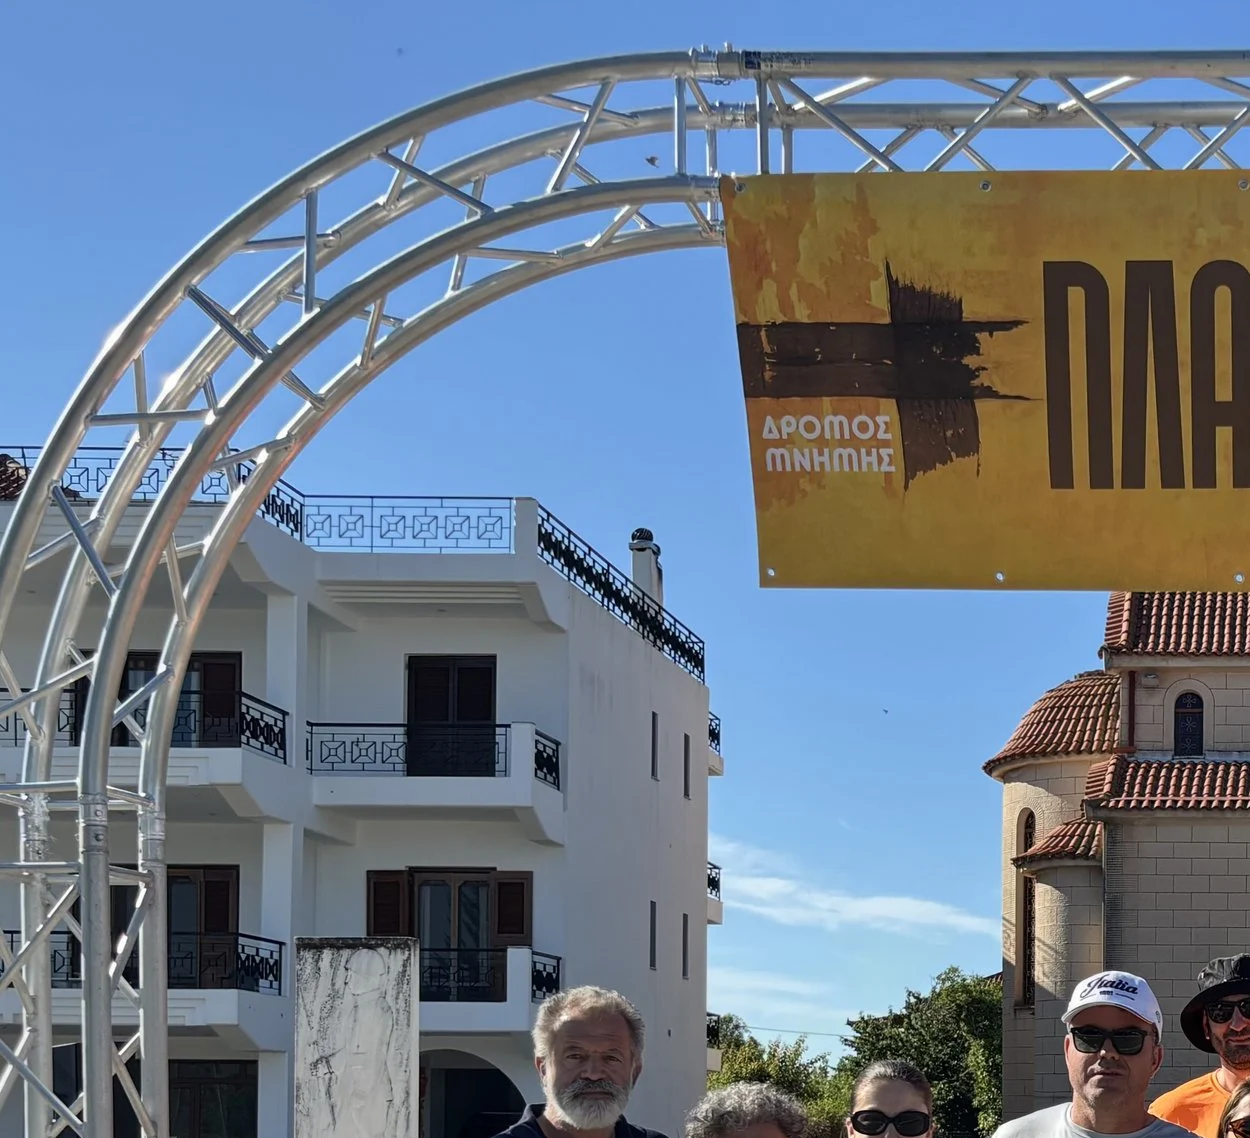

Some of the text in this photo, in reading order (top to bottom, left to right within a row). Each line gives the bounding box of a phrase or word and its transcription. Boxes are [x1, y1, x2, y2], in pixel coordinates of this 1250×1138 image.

[762, 415, 893, 440] ΔΡΟΜΟΣ
[765, 447, 896, 472] ΜΝΗΜΗΣ
[1080, 973, 1138, 998] Italia
